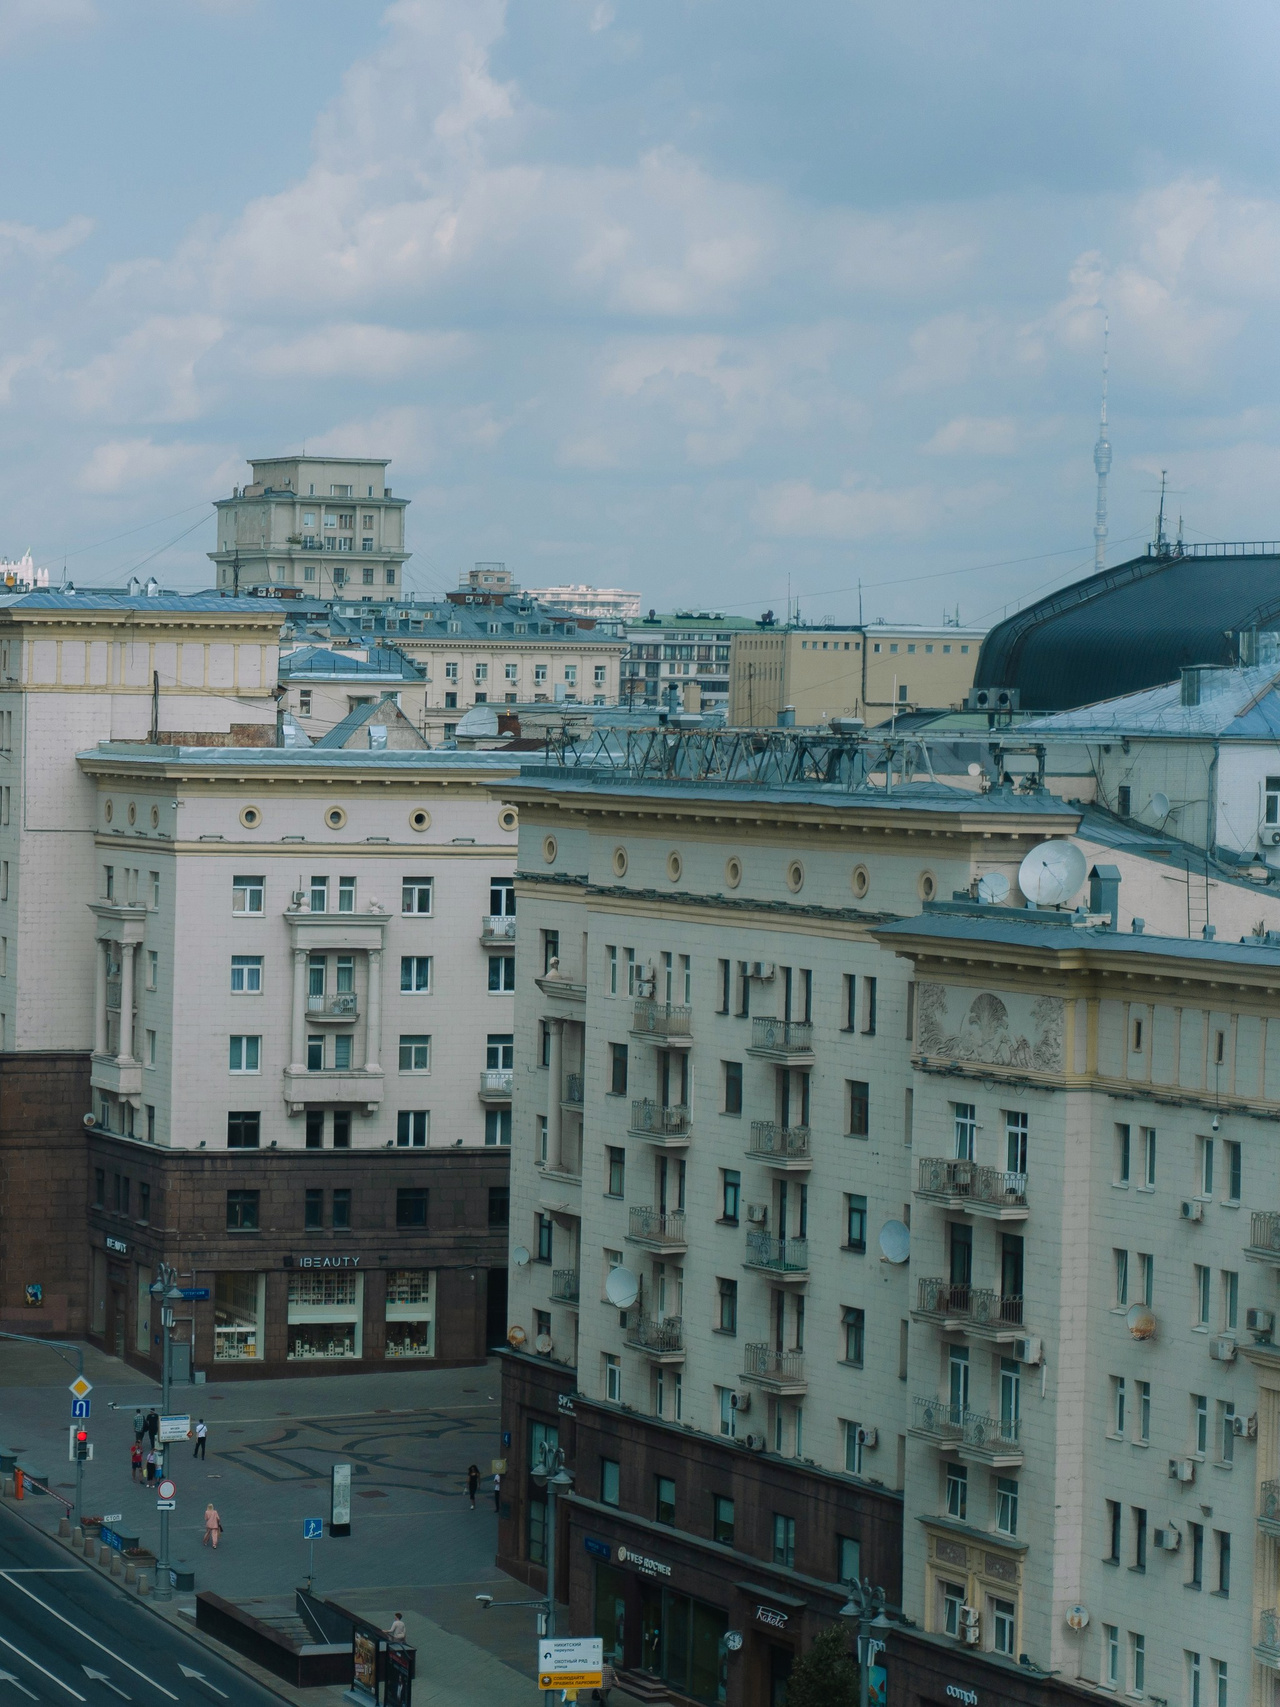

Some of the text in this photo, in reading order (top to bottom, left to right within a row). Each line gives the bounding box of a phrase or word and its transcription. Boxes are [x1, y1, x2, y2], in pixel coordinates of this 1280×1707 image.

[299, 1256, 360, 1268] IBEAUTY
[643, 1558, 672, 1576] ROCHER
[946, 1685, 978, 1706] oomph
